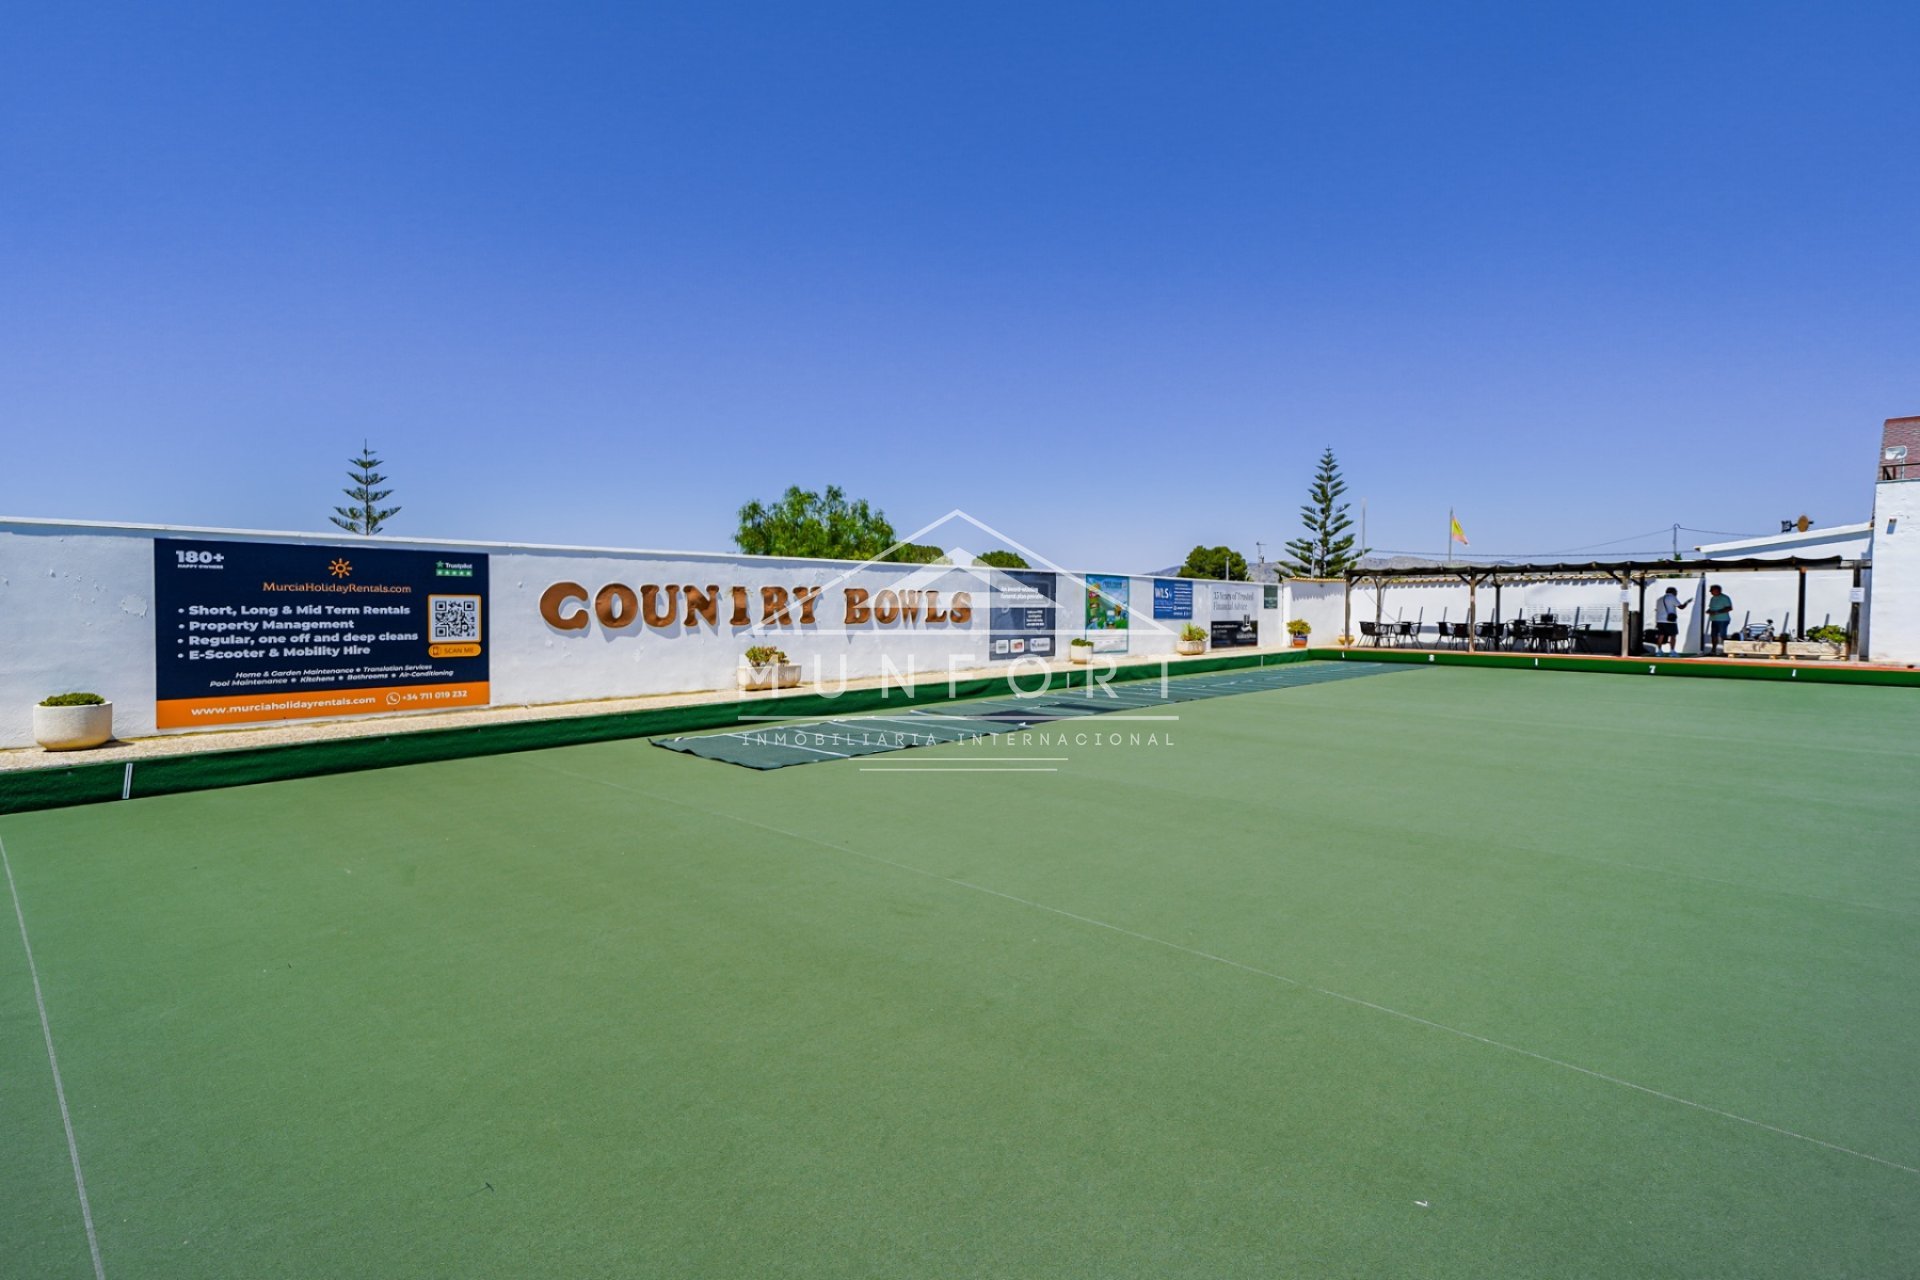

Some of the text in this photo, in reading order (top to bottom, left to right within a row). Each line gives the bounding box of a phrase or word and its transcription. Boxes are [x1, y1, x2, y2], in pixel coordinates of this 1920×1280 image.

[176, 550, 225, 564] 180+
[444, 562, 473, 570] Trustpilot
[263, 581, 412, 594] MurciaHolidayRentals.com
[188, 604, 411, 617] Short, Long & Mid Term Rentals
[843, 587, 972, 625] BOWLS
[189, 619, 355, 632] Property Management
[188, 631, 419, 647] Regular, one off and deep cleans
[189, 644, 371, 660] E-Scooter & Mobility Hire
[443, 647, 464, 655] SCAN
[235, 671, 262, 679] Home
[262, 670, 270, 678] &
[271, 668, 302, 677] Garden
[303, 667, 354, 676] Maintenance
[363, 665, 403, 673] Translation
[1648, 664, 1657, 674] 7
[209, 669, 453, 688] Pool Maintenance Kitchens Bathrooms Air-Conditioning
[402, 693, 418, 701] +34
[420, 692, 433, 700] 711
[435, 691, 450, 700] 019
[191, 697, 375, 715] www.murciaholidayrentals.com
